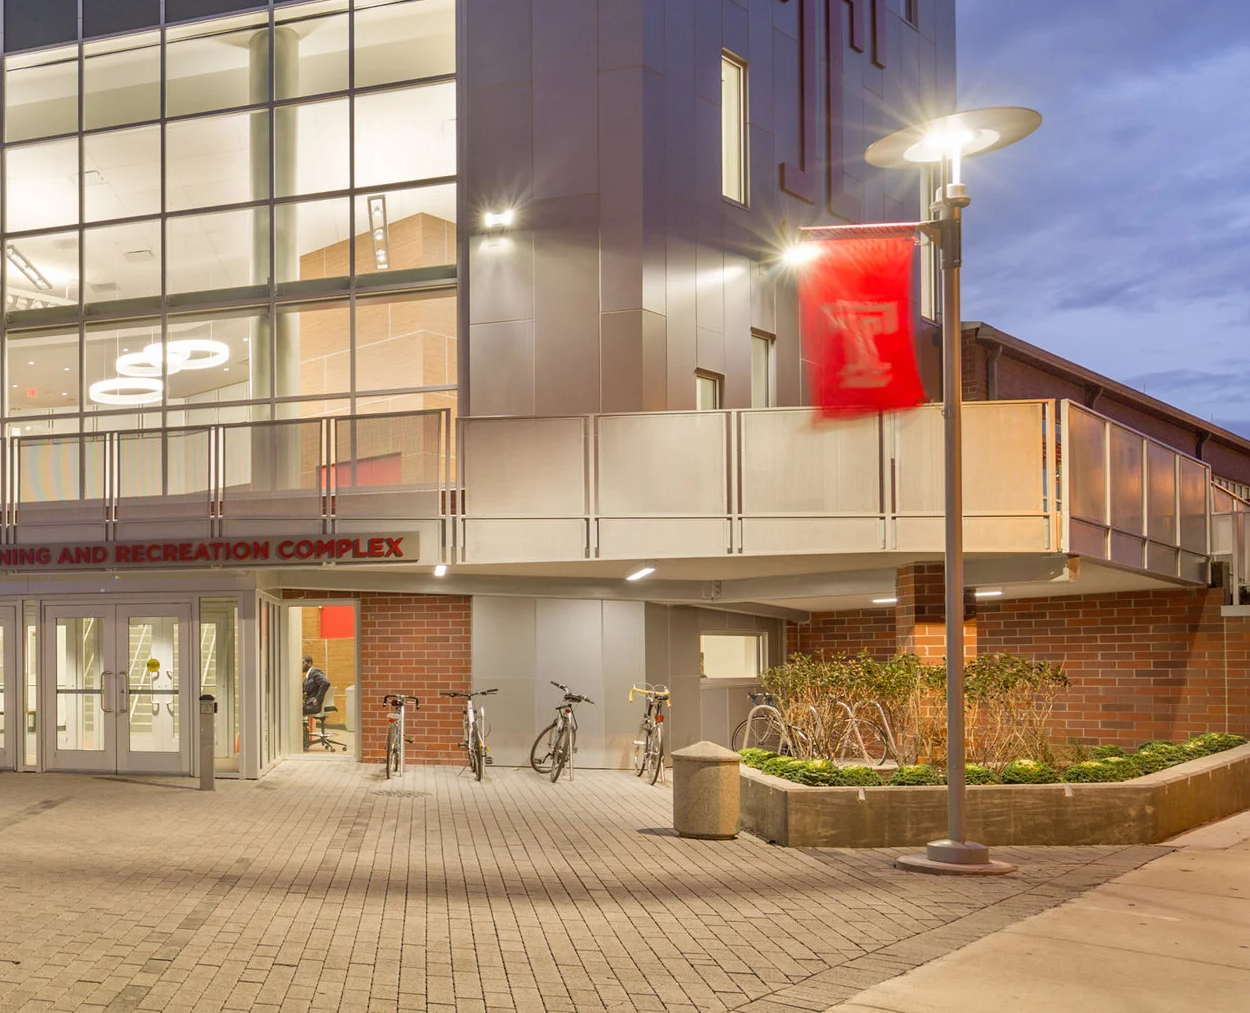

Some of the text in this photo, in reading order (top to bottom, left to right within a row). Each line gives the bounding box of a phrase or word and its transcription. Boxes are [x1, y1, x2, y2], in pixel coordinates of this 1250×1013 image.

[57, 545, 108, 566] AND
[115, 540, 270, 564] RECREATION
[277, 537, 404, 559] COMPLEX
